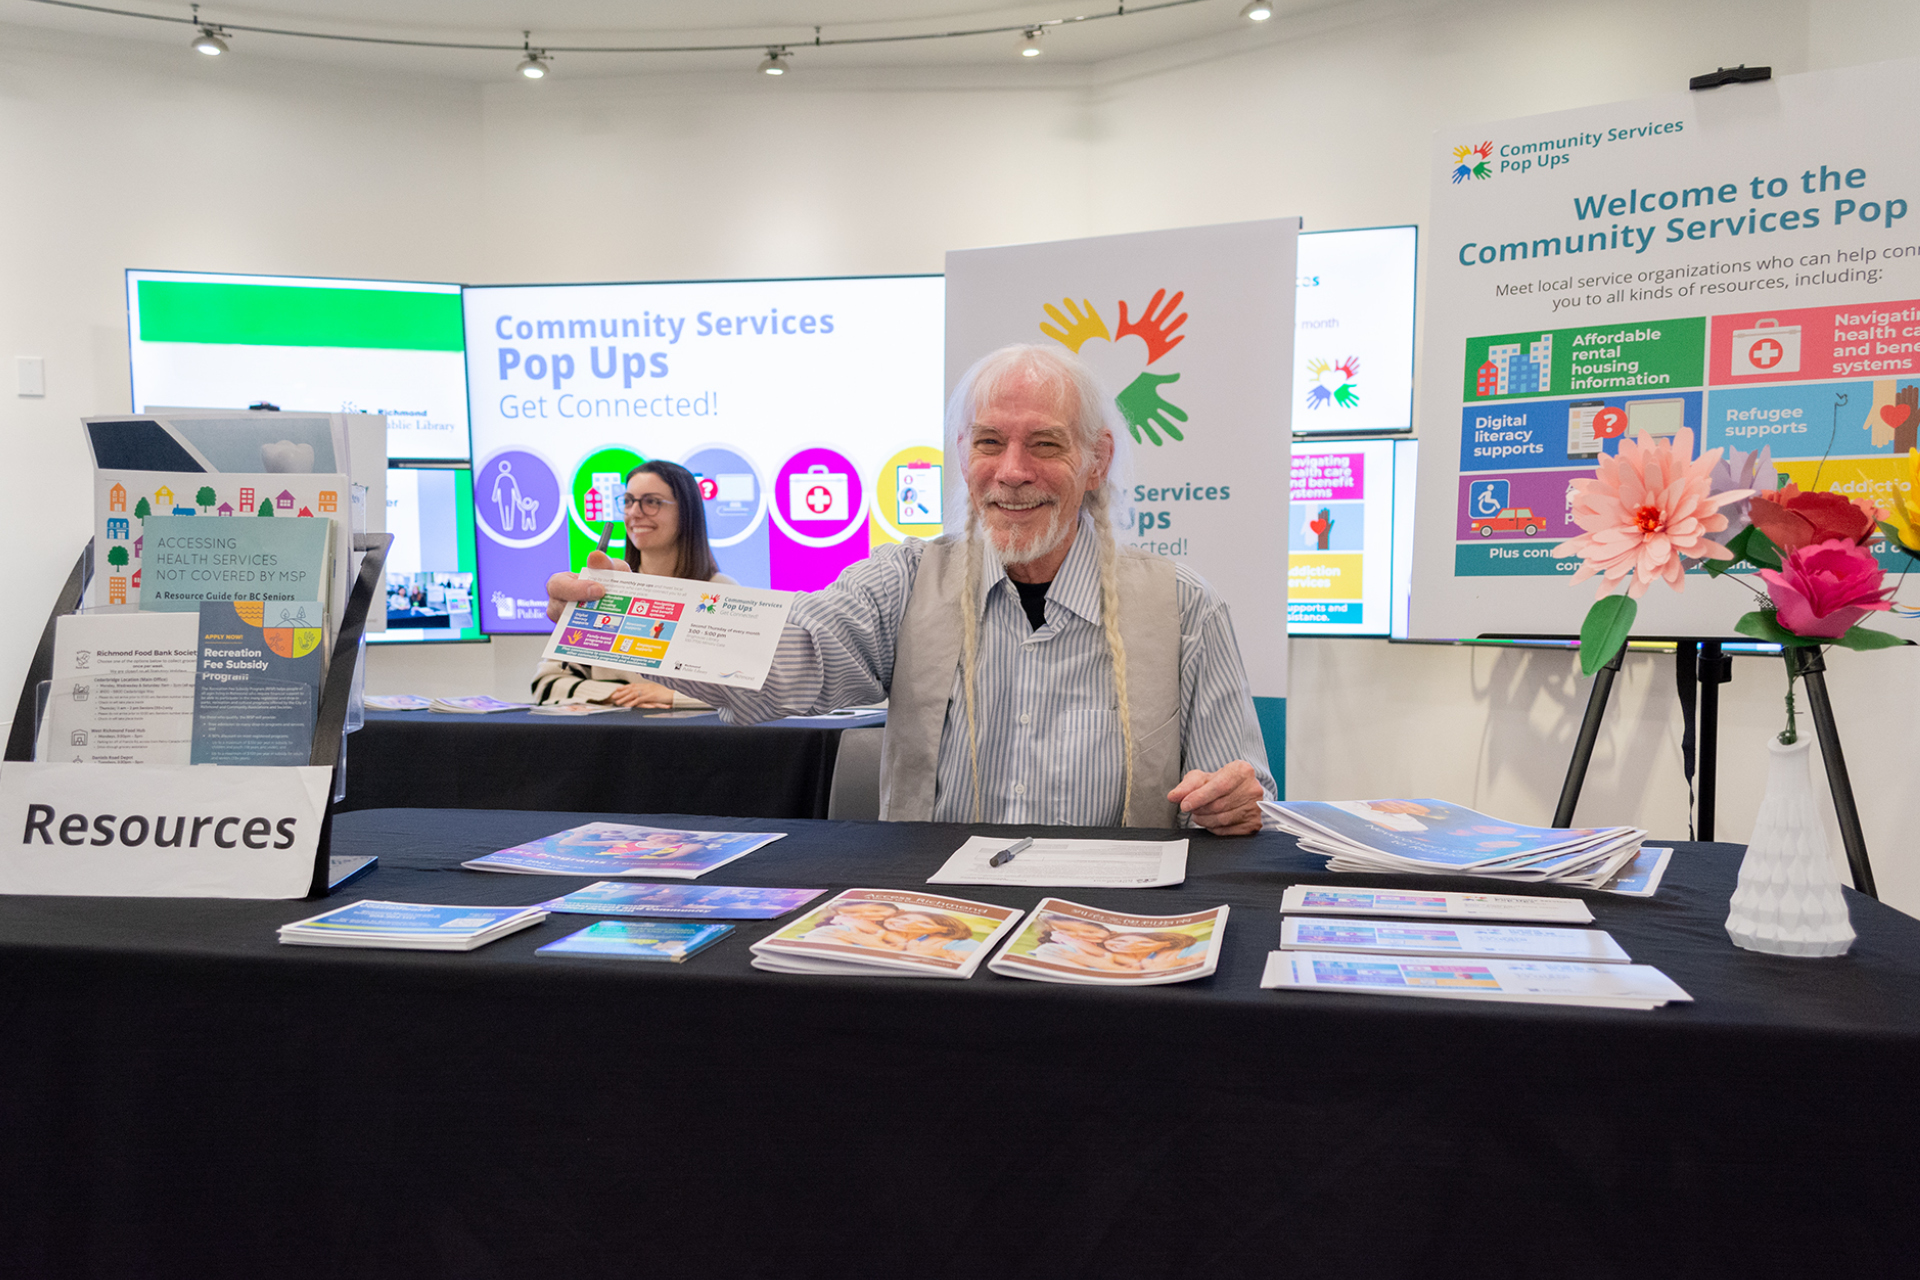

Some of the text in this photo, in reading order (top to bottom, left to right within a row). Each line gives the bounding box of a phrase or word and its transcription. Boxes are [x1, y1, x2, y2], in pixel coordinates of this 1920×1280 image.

[1500, 120, 1684, 158] Community Services
[1500, 152, 1570, 174] Pop Ups
[1573, 165, 1866, 220] Welcome to the
[1458, 198, 1909, 266] Community Services Pop
[1496, 245, 1920, 297] Meet local service organizations who can help con
[1552, 267, 1884, 312] you to all kinds of resources, including:
[495, 308, 835, 344] Community Services
[1302, 318, 1340, 329] month
[1572, 328, 1661, 347] Affordable
[1834, 326, 1896, 342] health
[1572, 345, 1621, 361] rental
[1833, 342, 1870, 357] and
[499, 346, 669, 389] Pop Ups
[1571, 359, 1639, 376] housing
[1832, 358, 1912, 375] systems
[1571, 373, 1670, 390] information
[499, 391, 718, 420] Get Connected!
[1475, 414, 1527, 429] Digital
[1726, 406, 1803, 424] Refugee
[416, 420, 455, 432] Library
[1725, 421, 1808, 438] supports
[1474, 428, 1533, 444] literacy
[1473, 442, 1544, 458] supports
[1324, 467, 1352, 477] care
[1308, 476, 1354, 488] benefit
[1134, 482, 1230, 502] Services
[158, 537, 237, 549] ACCESSING
[157, 553, 278, 566] HEALTH SERVICES
[1489, 547, 1520, 559] Plus
[156, 570, 307, 582] NOT COVERED BY MSP
[155, 592, 295, 601] A Resource Guide for BC Seniors
[724, 597, 783, 609] Community Services
[517, 608, 546, 619] Public
[722, 602, 753, 612] Pop Ups
[1328, 603, 1348, 613] and
[204, 648, 261, 657] Recreation
[203, 660, 223, 668] Fee
[225, 660, 269, 671] Subsidy
[23, 803, 298, 850] Resources
[536, 853, 607, 865] Programs
[864, 893, 912, 901] Access
[916, 898, 988, 913] Richmond
